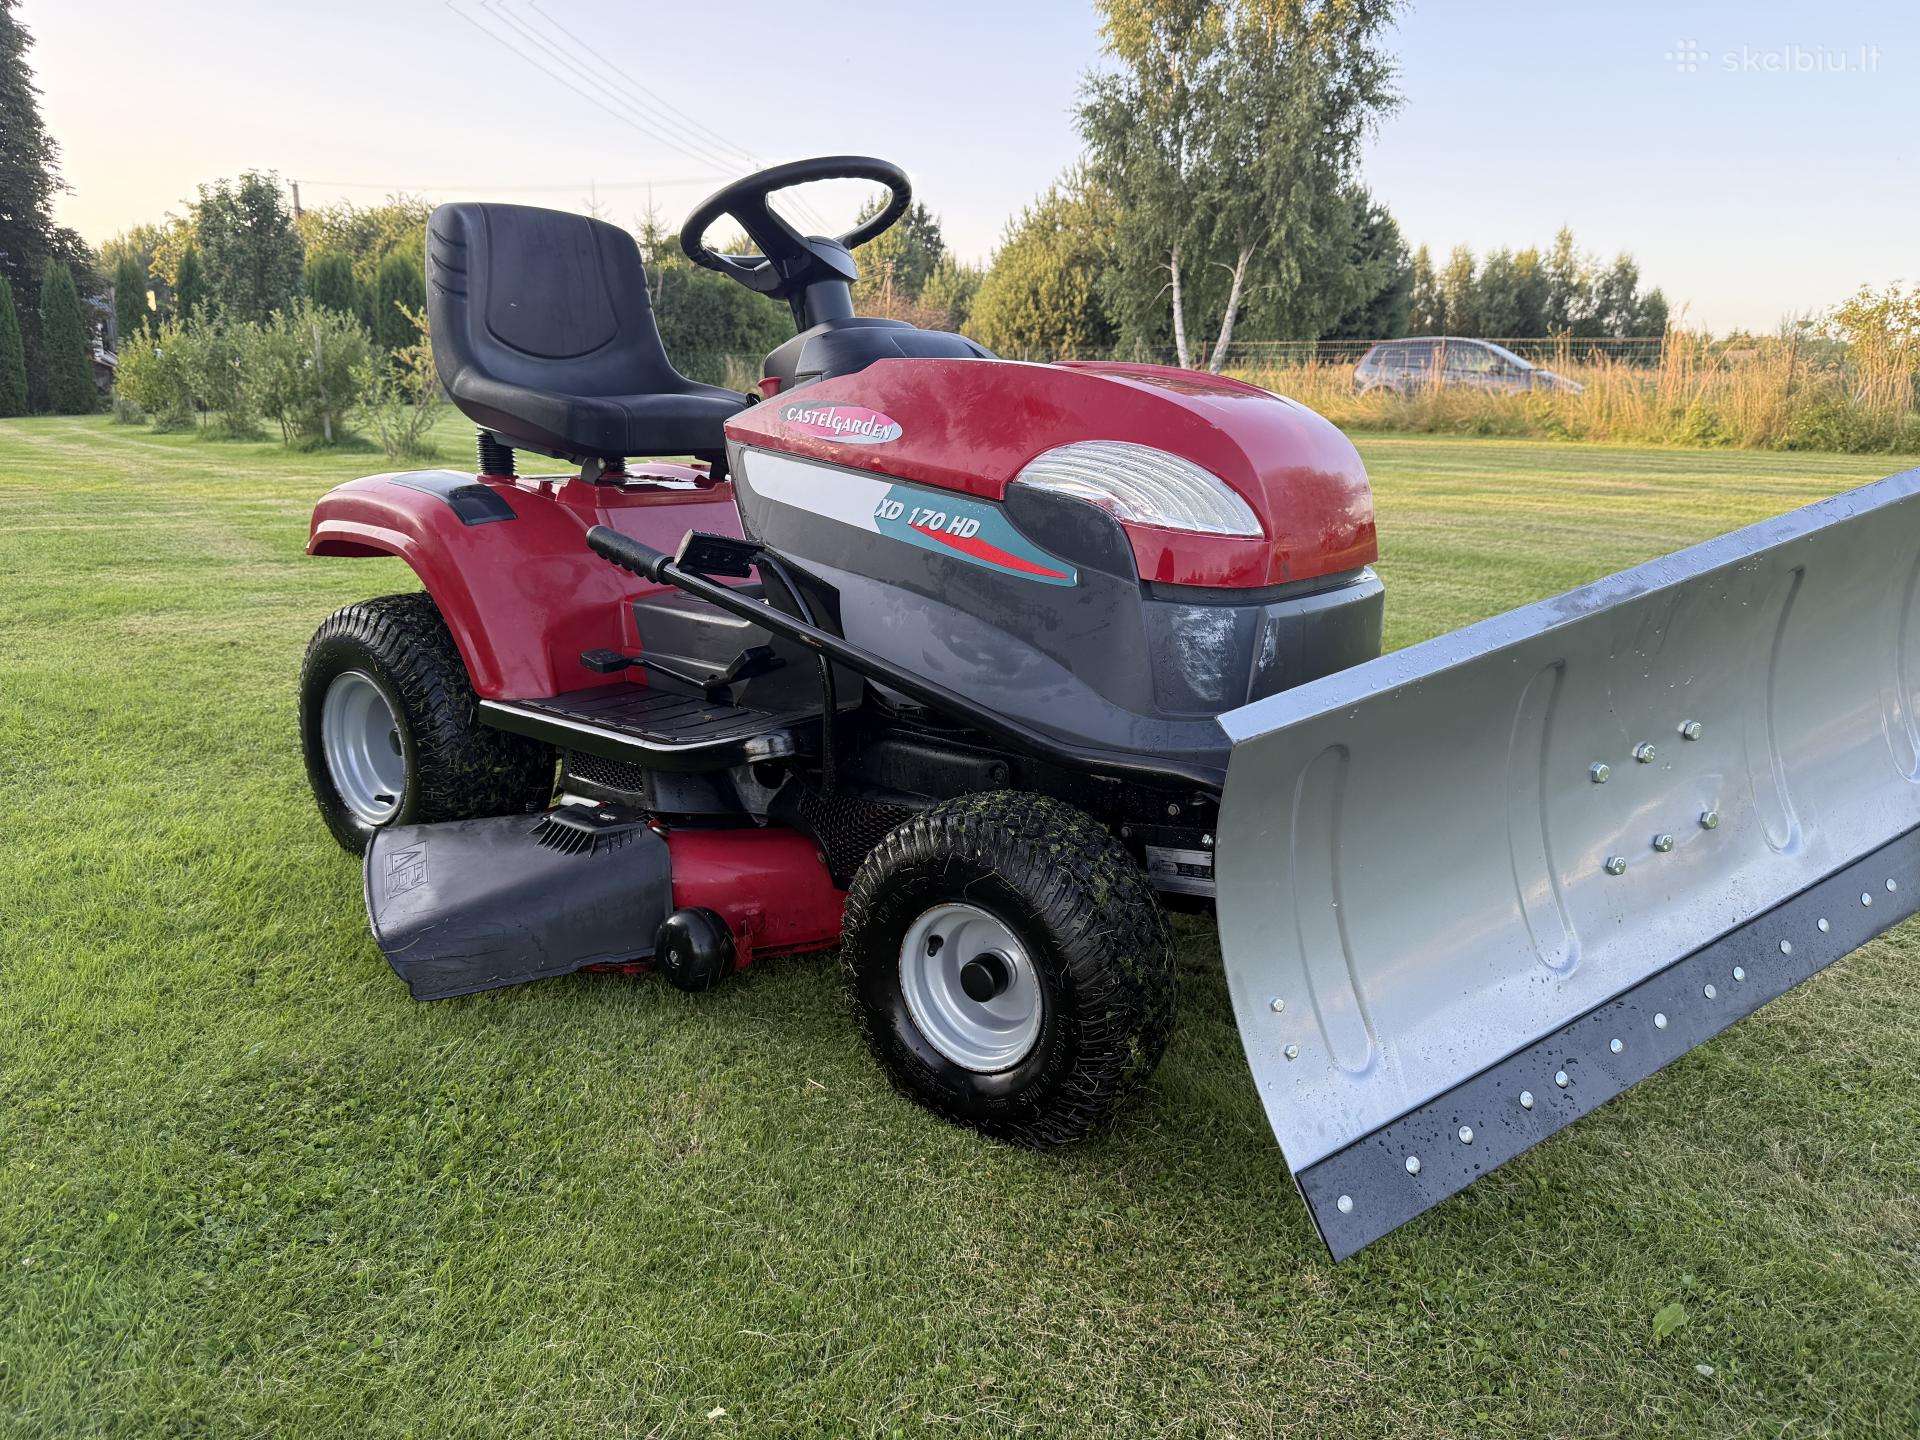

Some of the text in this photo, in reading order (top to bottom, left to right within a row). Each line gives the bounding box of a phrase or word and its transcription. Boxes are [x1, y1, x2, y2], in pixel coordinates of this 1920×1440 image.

[873, 499, 981, 539] XD 170 HD
